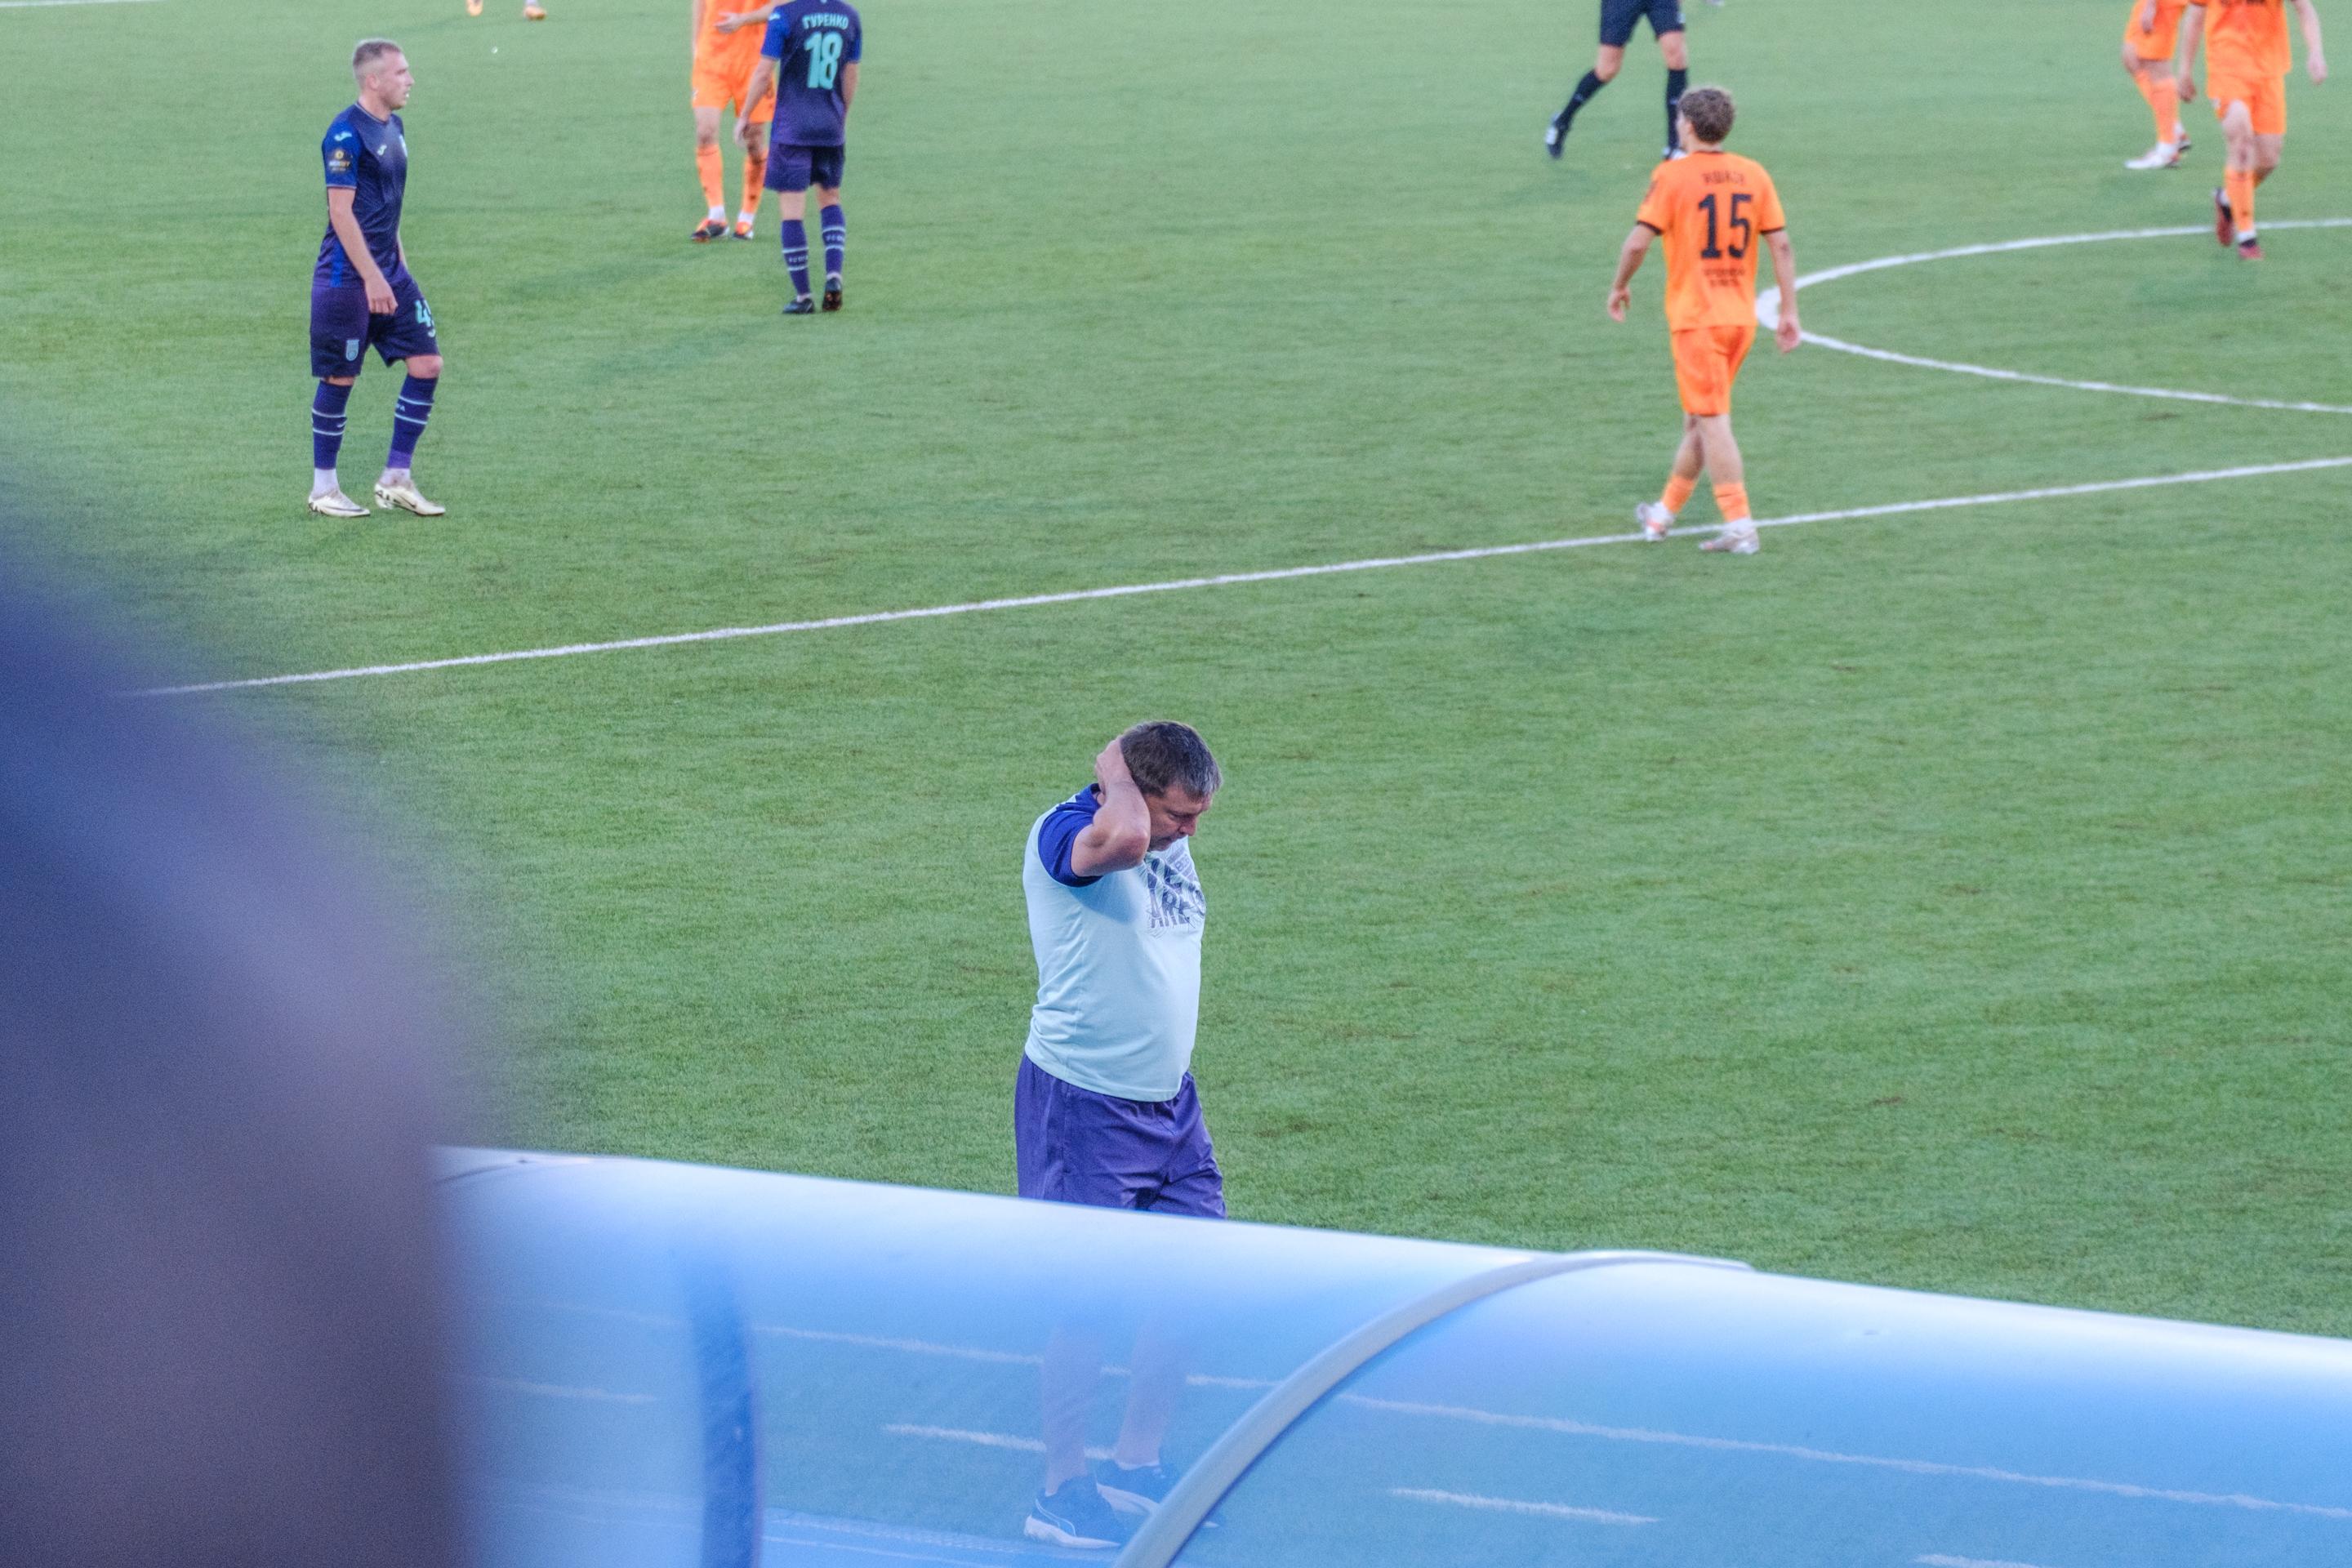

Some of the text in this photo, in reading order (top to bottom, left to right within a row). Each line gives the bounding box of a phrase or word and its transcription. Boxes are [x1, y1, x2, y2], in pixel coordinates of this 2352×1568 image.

[802, 13, 849, 29] ГУРЕНКО
[804, 31, 843, 90] 18
[1698, 193, 1753, 260] 15
